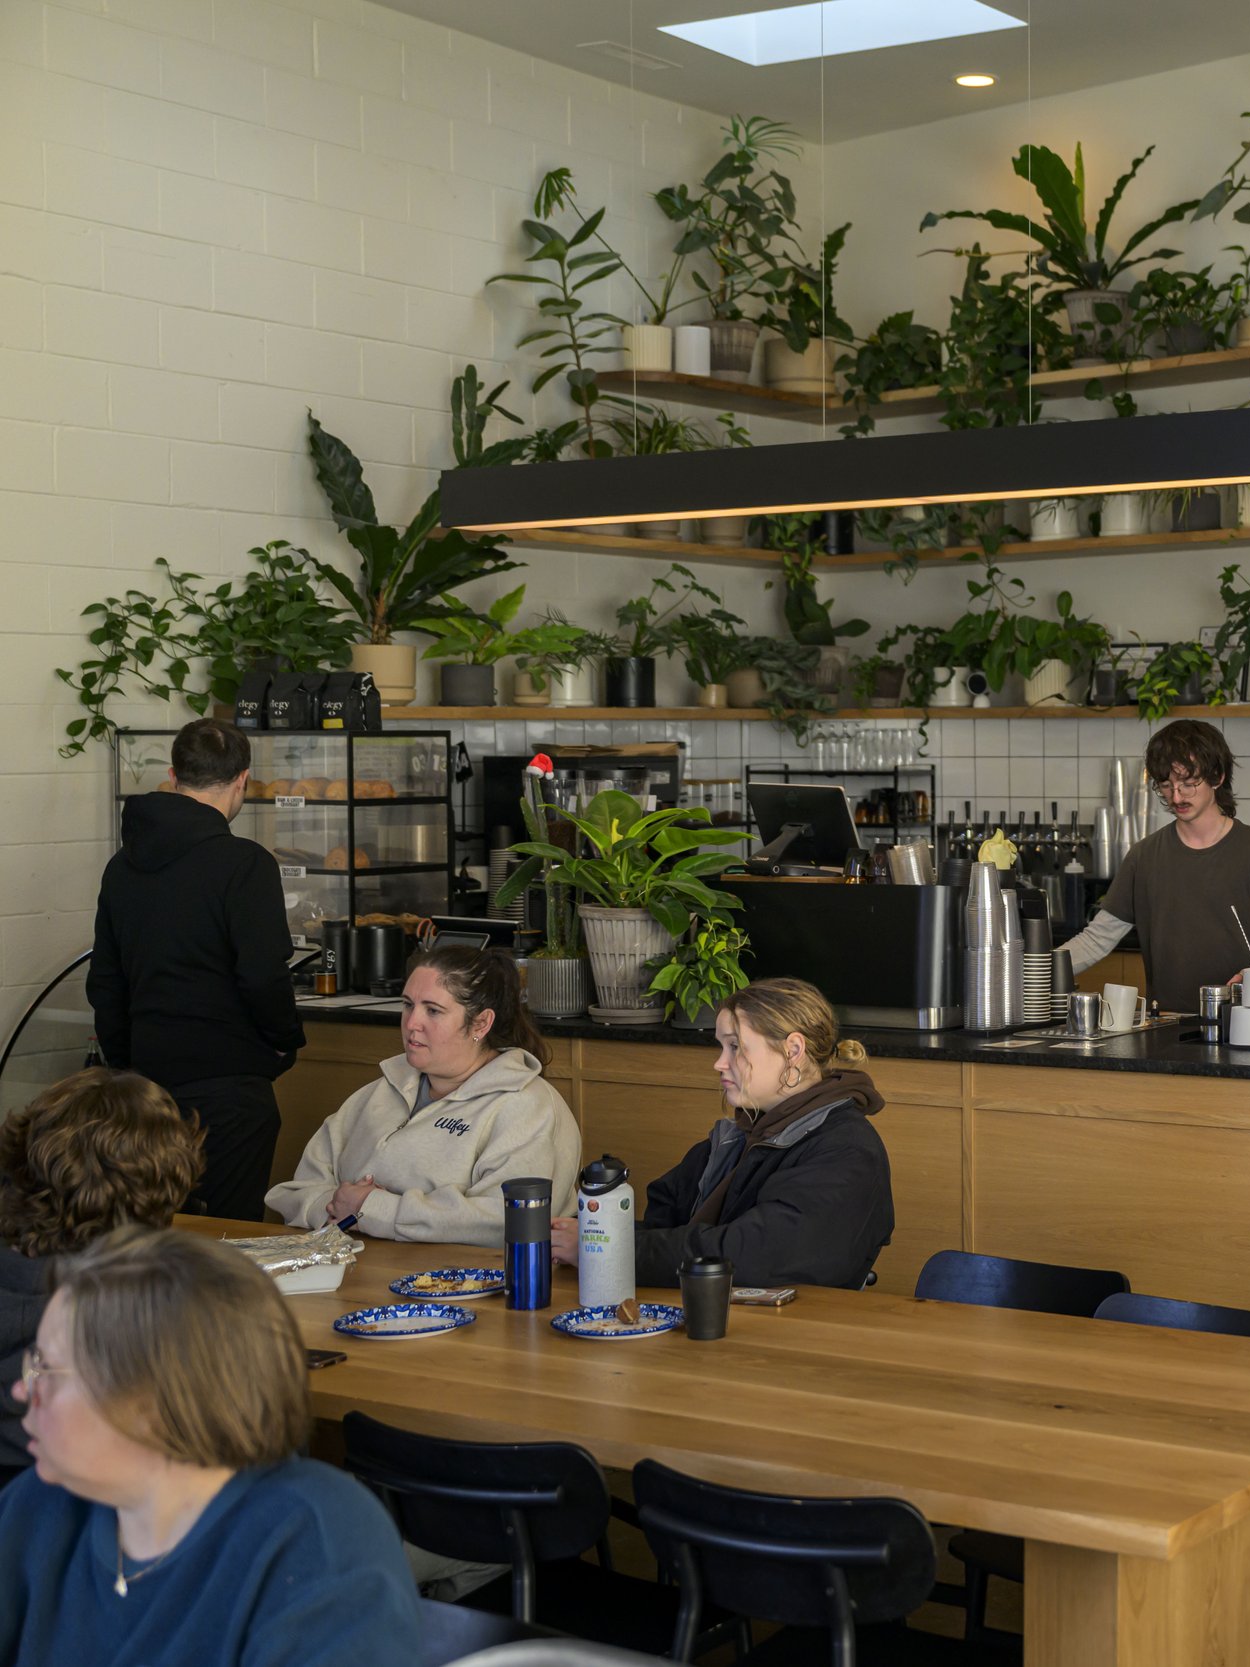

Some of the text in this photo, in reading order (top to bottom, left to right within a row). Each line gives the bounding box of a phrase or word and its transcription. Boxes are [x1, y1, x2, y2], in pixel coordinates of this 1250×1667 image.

[322, 700, 344, 710] elegy
[326, 948, 336, 969] egy
[434, 1117, 470, 1136] Wifey
[585, 1245, 604, 1253] USA
